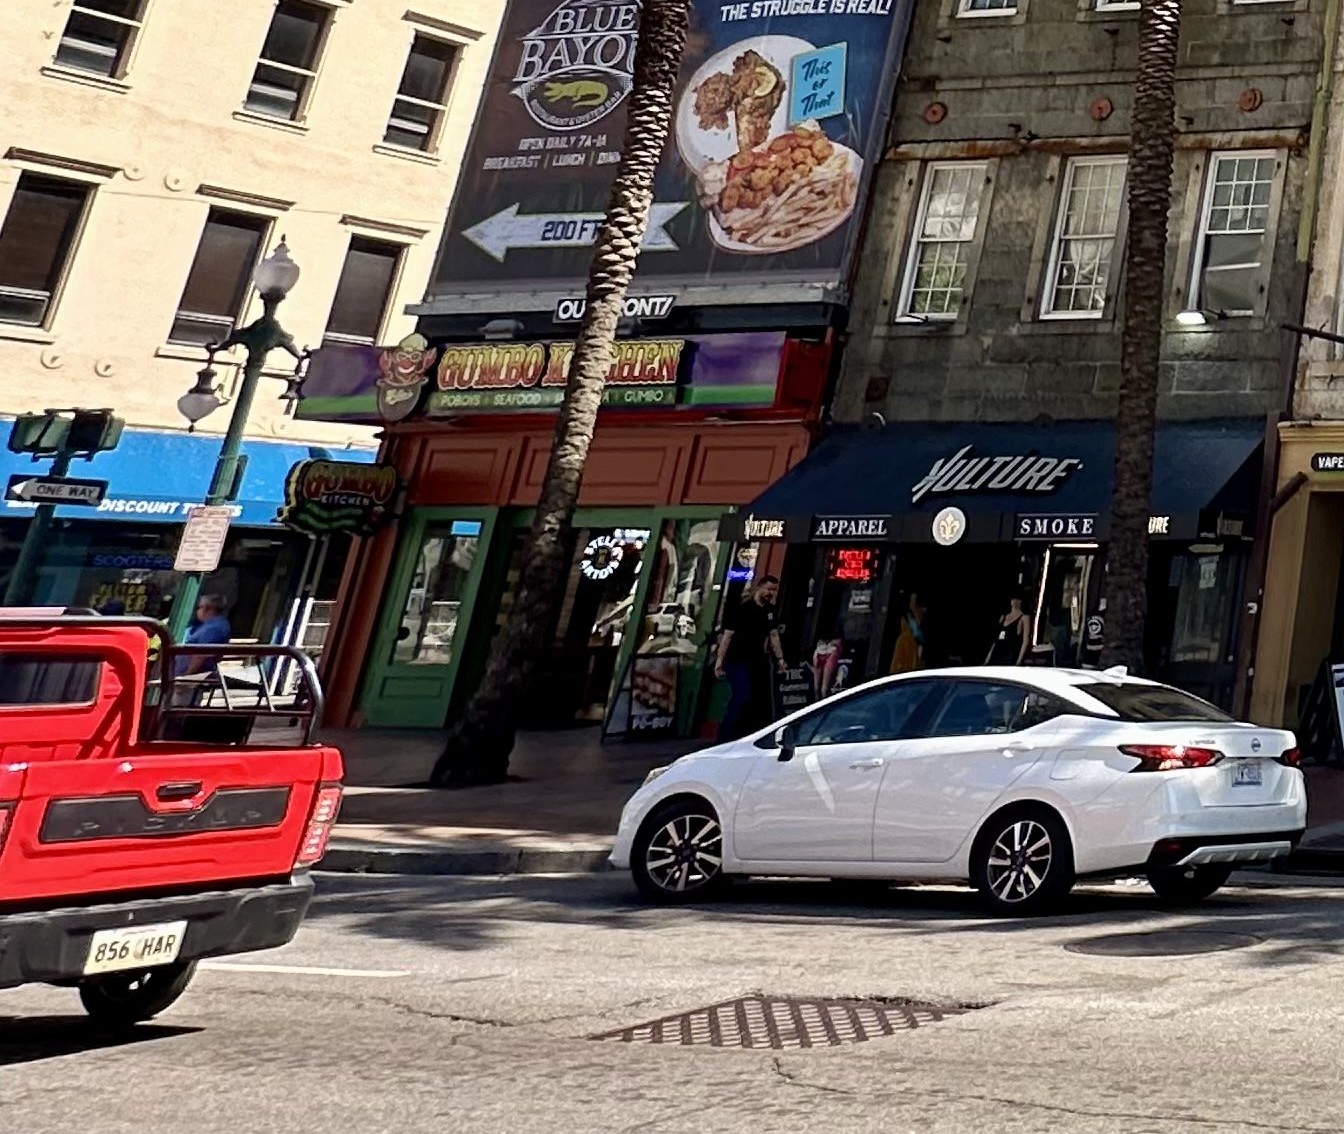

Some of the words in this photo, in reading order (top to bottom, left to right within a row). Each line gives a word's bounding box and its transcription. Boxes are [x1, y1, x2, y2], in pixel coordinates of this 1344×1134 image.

[553, 4, 638, 34] BLUE
[720, 3, 750, 22] THE
[801, 57, 832, 81] This
[801, 90, 836, 115] That
[518, 137, 545, 151] OPEN
[545, 135, 577, 149] DAILY
[483, 154, 542, 170] BREAKFAST
[552, 152, 586, 167] LUNCH
[596, 151, 622, 165] DINN
[541, 220, 577, 241] 200
[558, 296, 674, 320] OUONT/
[438, 343, 546, 390] GUMBO
[542, 339, 685, 388] KCHEN
[493, 392, 542, 407] SEAFOOD
[624, 390, 664, 402] GUMBO
[912, 444, 1080, 504] VULTURE
[36, 484, 63, 496] ONE
[67, 485, 96, 498] WAY
[321, 495, 370, 506] KITCHEN
[97, 499, 180, 515] DISCOUNT
[814, 519, 888, 536] APPAREL
[1020, 518, 1094, 535] SMOKE
[93, 554, 172, 566] SCOOTERS
[94, 940, 130, 964] 856
[140, 934, 177, 957] HAR
